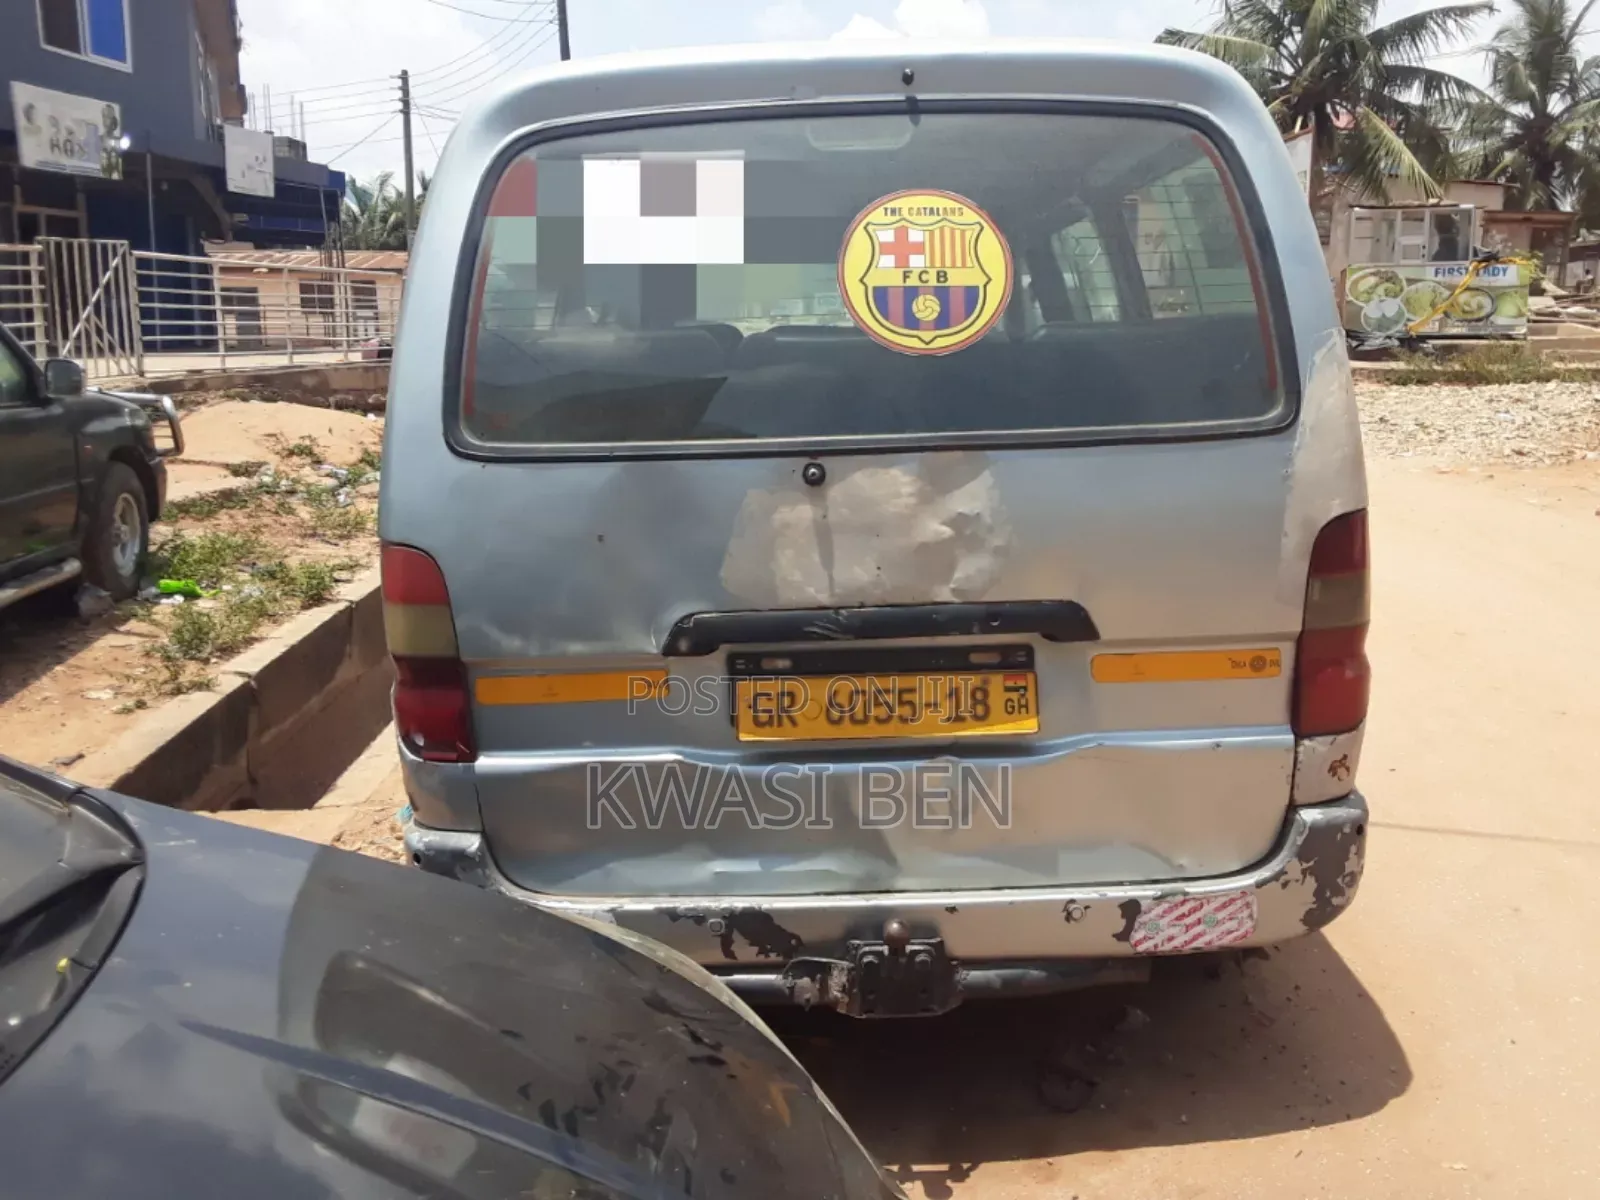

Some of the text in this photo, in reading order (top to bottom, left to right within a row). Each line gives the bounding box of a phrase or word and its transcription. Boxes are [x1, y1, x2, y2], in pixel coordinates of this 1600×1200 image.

[883, 207, 964, 217] THE CATALANS
[902, 270, 949, 285] FCB
[752, 684, 992, 728] GR 6055-18
[1004, 697, 1029, 716] GH
